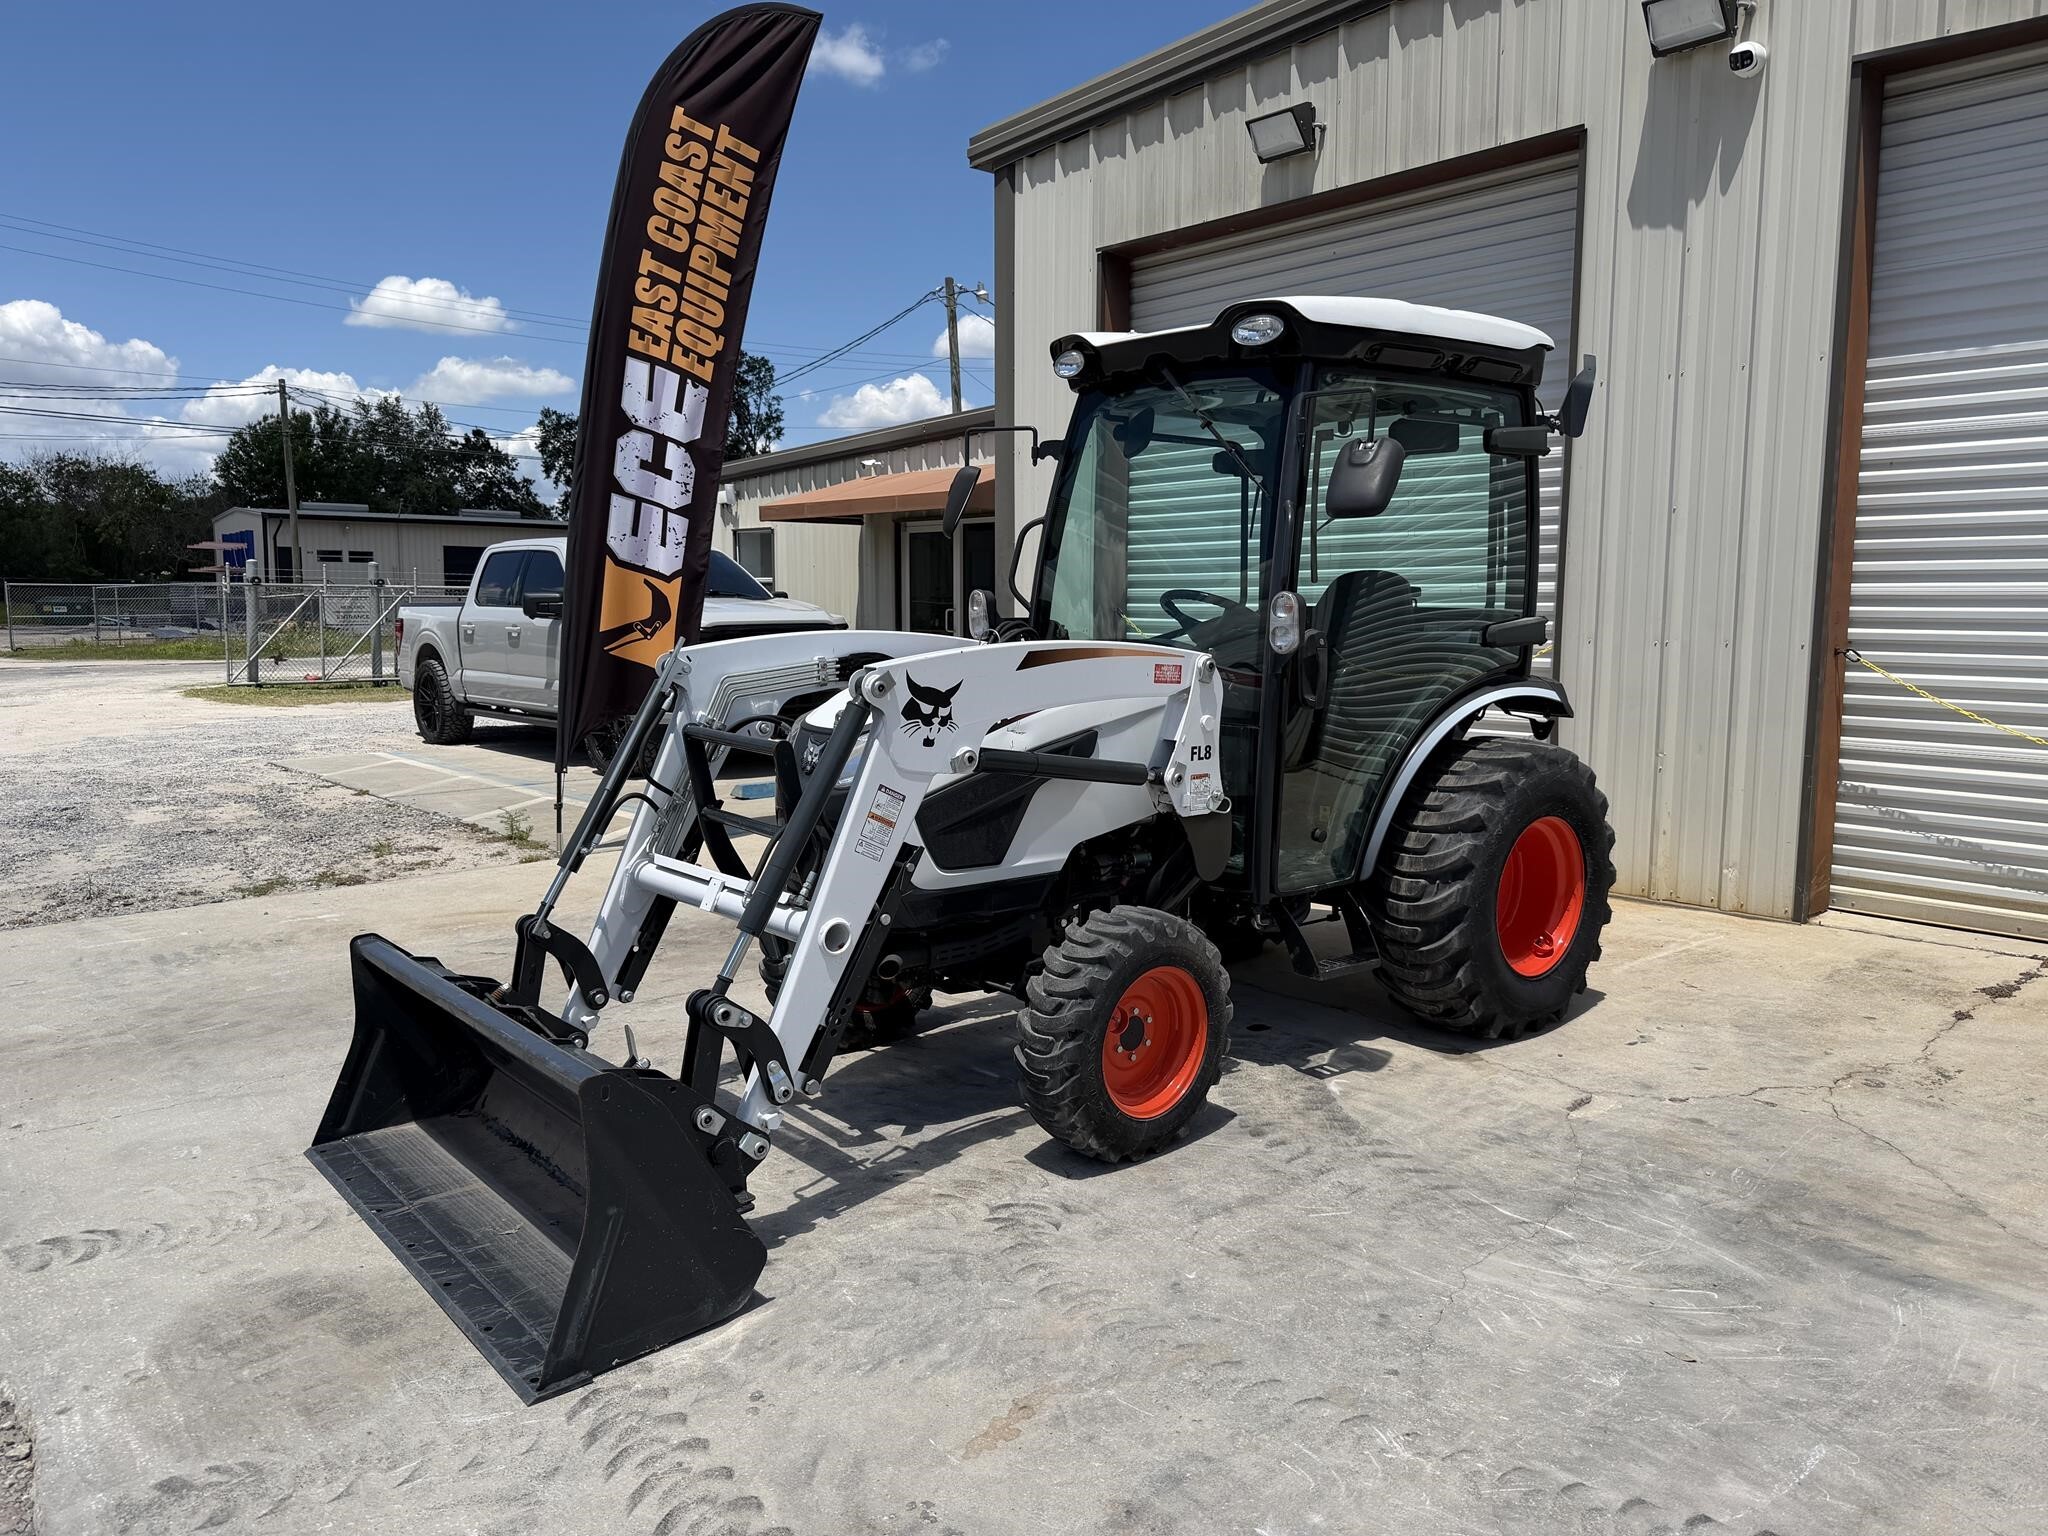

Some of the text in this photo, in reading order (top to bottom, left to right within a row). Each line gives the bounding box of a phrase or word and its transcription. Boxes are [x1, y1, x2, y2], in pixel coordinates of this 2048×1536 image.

[628, 105, 714, 362] EAST COAST
[671, 124, 761, 383] EQUIPMENT
[606, 355, 710, 577] ECE
[885, 786, 904, 801] DANGER
[1190, 745, 1212, 762] FL8
